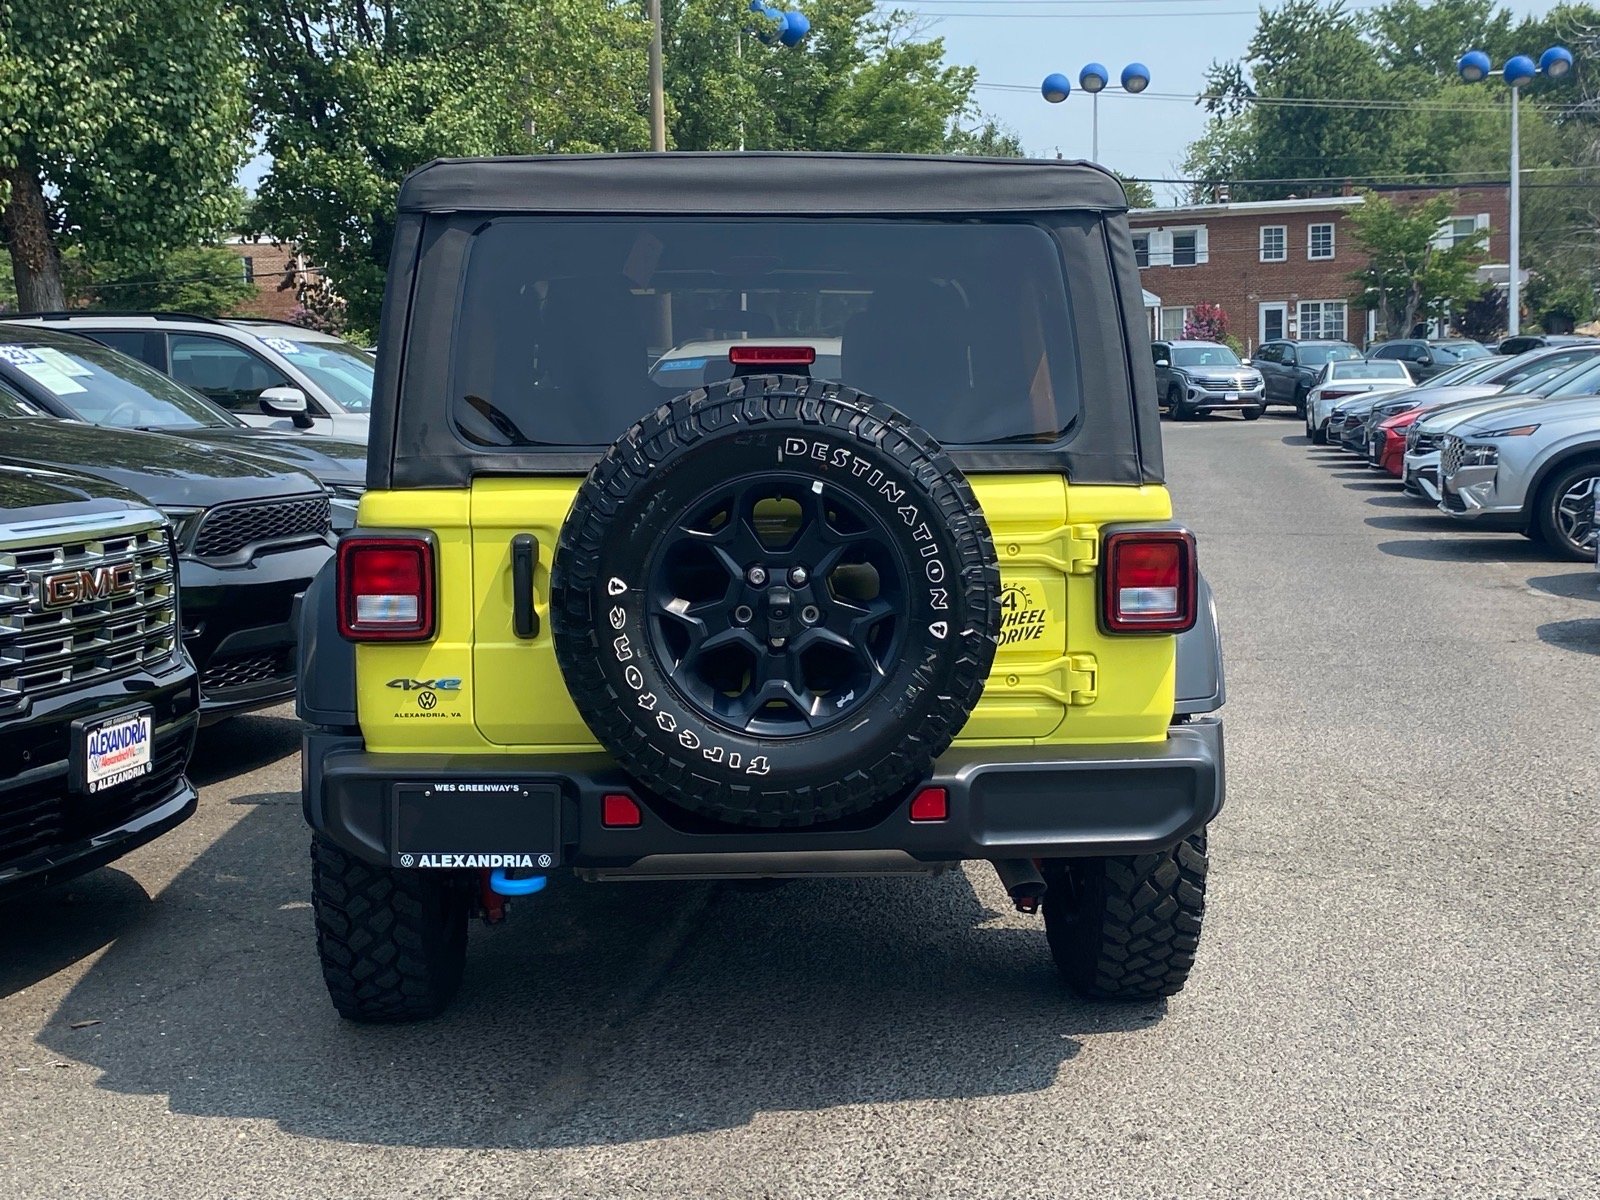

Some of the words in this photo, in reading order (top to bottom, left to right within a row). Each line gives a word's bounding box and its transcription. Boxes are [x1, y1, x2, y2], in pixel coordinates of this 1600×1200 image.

[785, 437, 948, 610] DESTINATION
[47, 562, 136, 605] GMC
[1001, 591, 1017, 611] 4
[609, 605, 770, 775] Firestone
[88, 720, 147, 760] ALEXANDRIA
[97, 764, 146, 792] ALEXANDRIA
[434, 784, 456, 792] WES
[458, 784, 520, 792] GREENWAY'S
[418, 854, 533, 868] ALEXANDRIA
